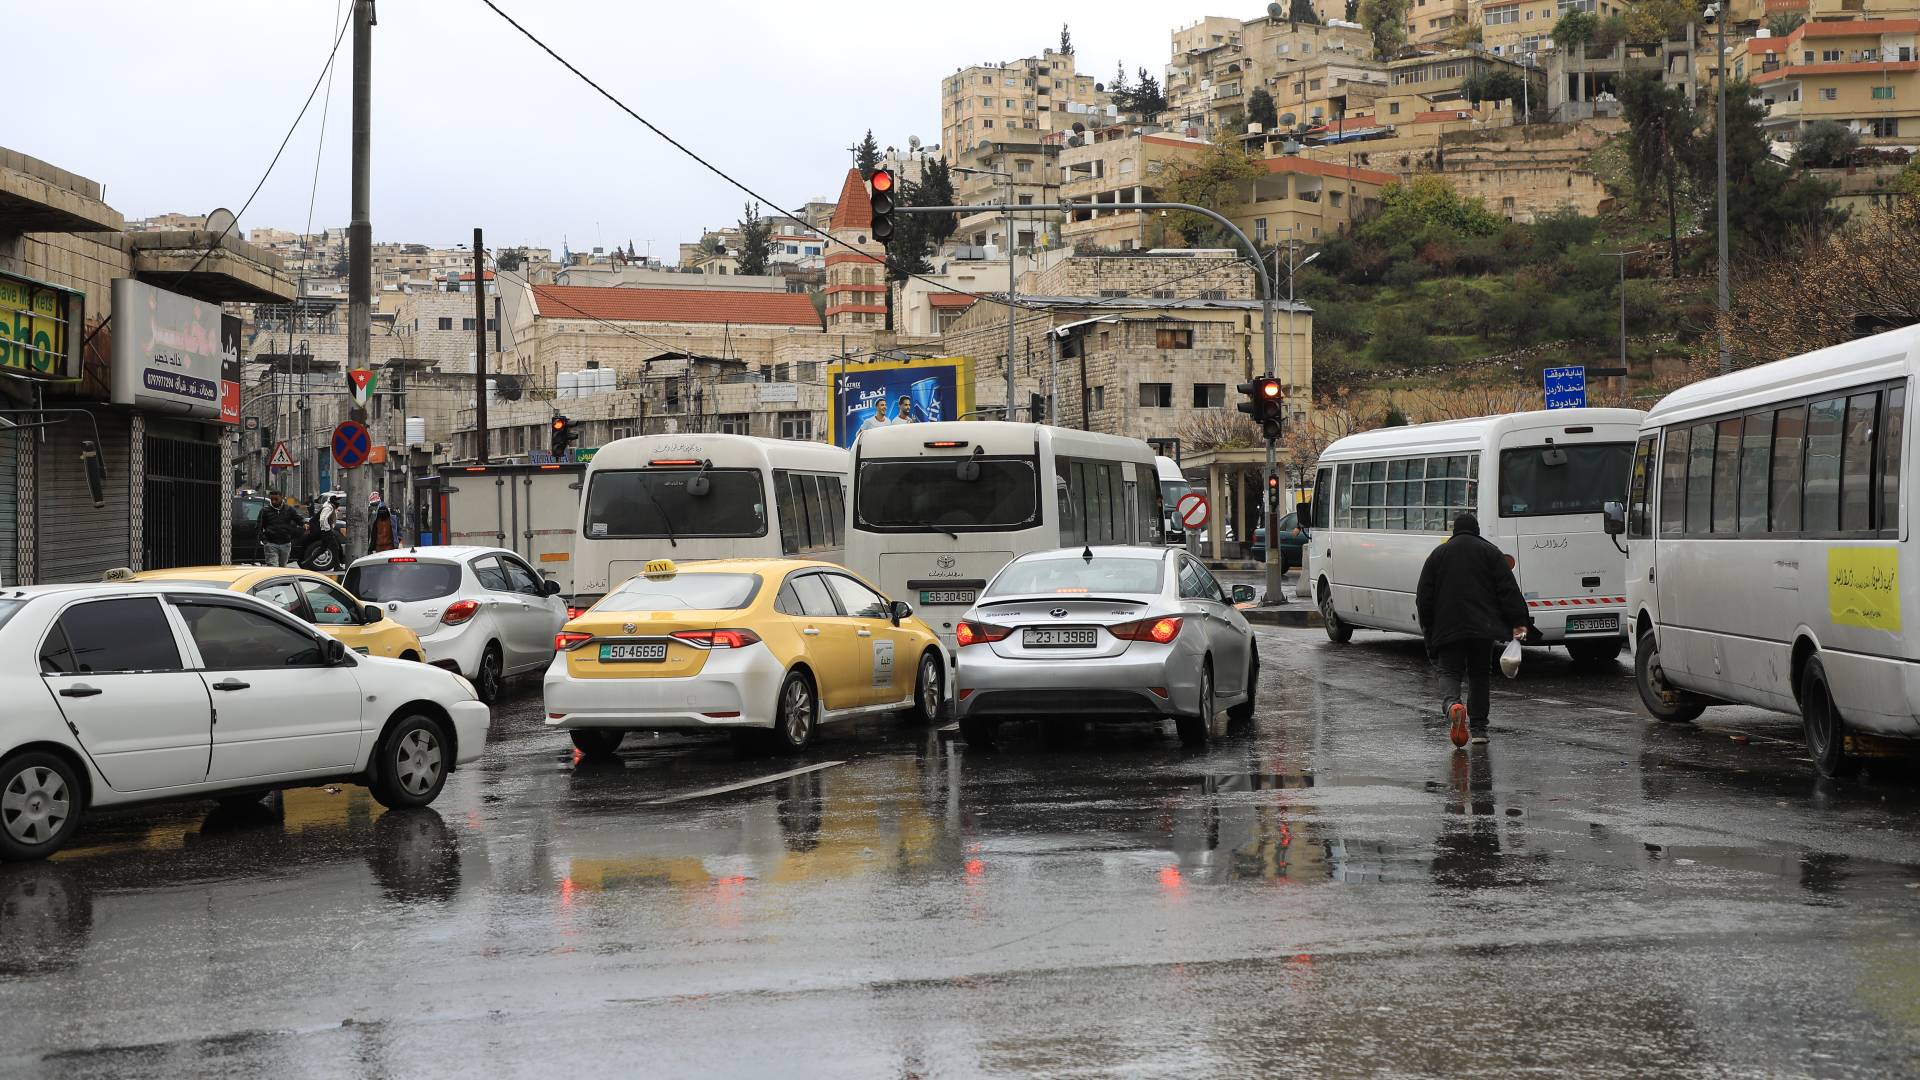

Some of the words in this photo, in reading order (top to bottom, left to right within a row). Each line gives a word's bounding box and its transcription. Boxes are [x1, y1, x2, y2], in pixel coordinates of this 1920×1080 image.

[0, 285, 16, 302] ave
[1547, 370, 1565, 379] موقف
[1566, 369, 1582, 379] بداية
[1564, 383, 1584, 391] متحف
[860, 386, 886, 400] نكهة
[846, 399, 873, 416] النصر
[1550, 398, 1582, 409] اليادودة
[647, 563, 667, 572] TAXI
[929, 592, 973, 602] 56-30490
[1036, 631, 1094, 643] 23-13988
[611, 645, 664, 657] 50-46658
